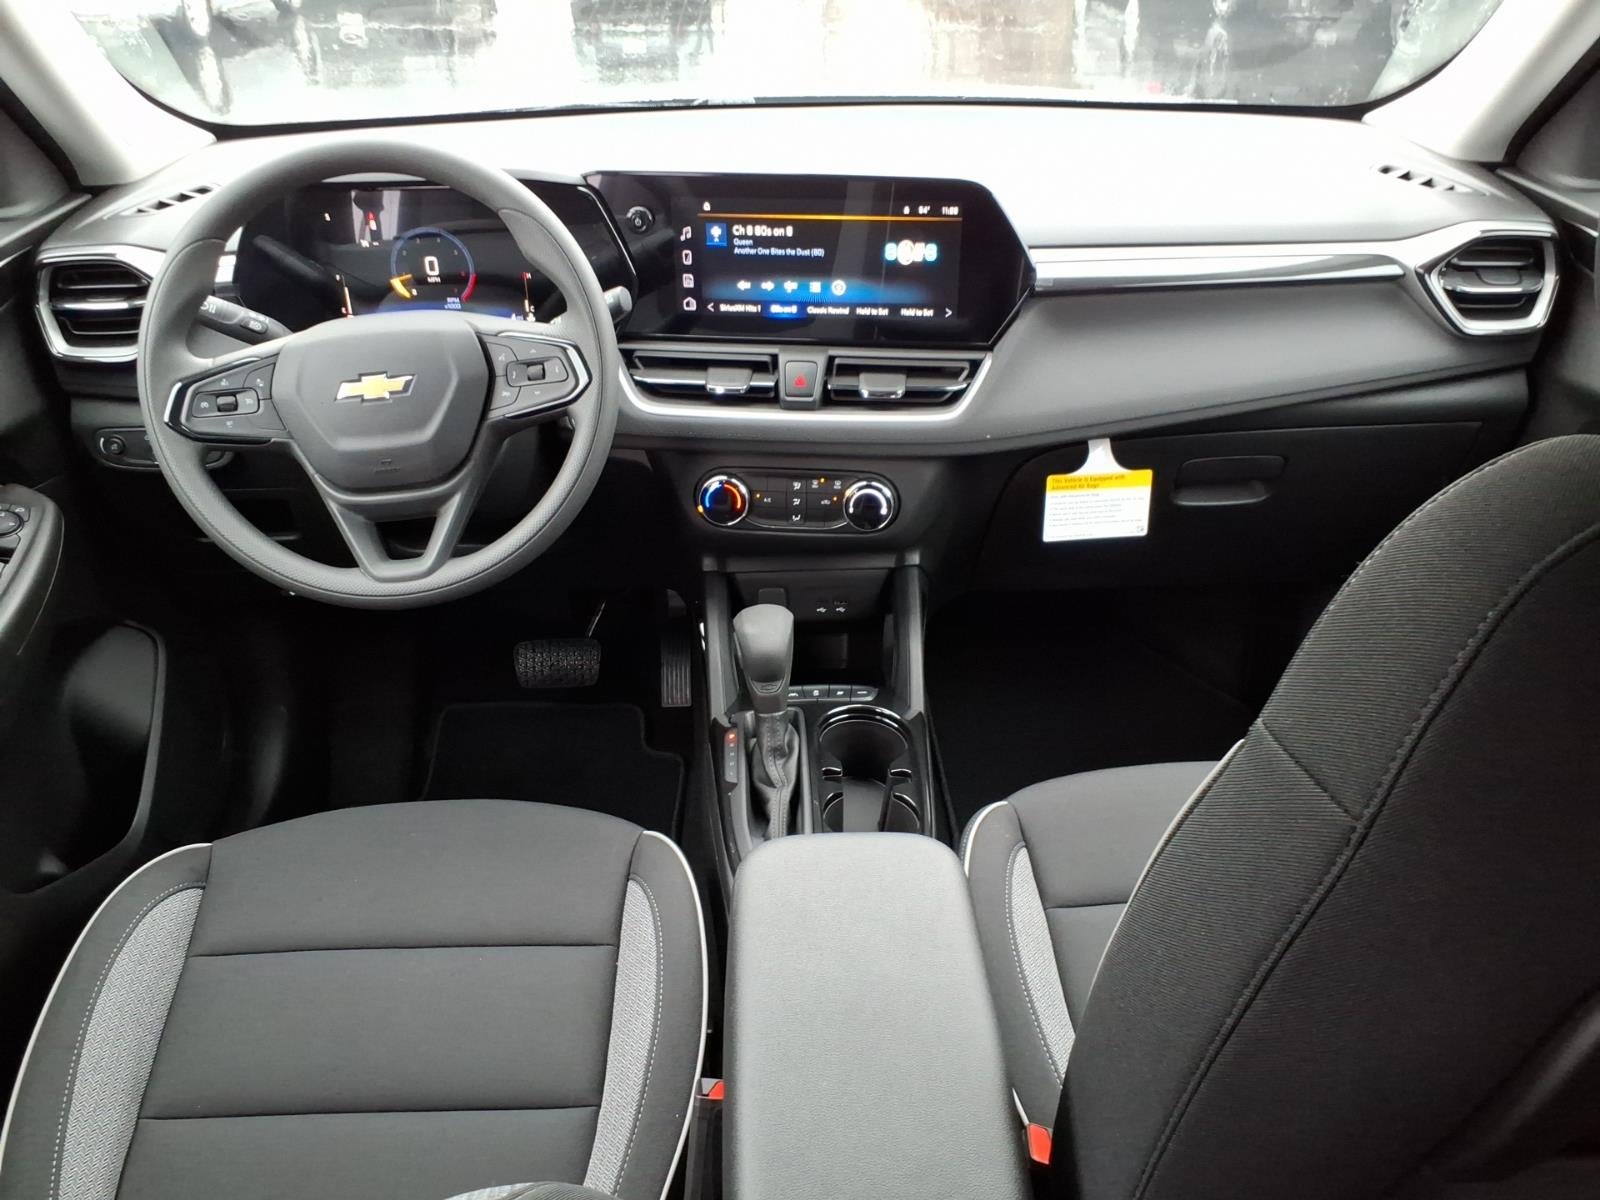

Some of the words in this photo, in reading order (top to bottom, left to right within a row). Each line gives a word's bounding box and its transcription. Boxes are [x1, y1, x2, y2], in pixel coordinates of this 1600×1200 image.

[733, 225, 745, 236] Ch
[773, 228, 785, 237] on
[733, 238, 754, 246] Queen
[734, 247, 757, 255] Another
[786, 248, 796, 256] the
[796, 248, 810, 256] Dust
[424, 256, 439, 276] 0
